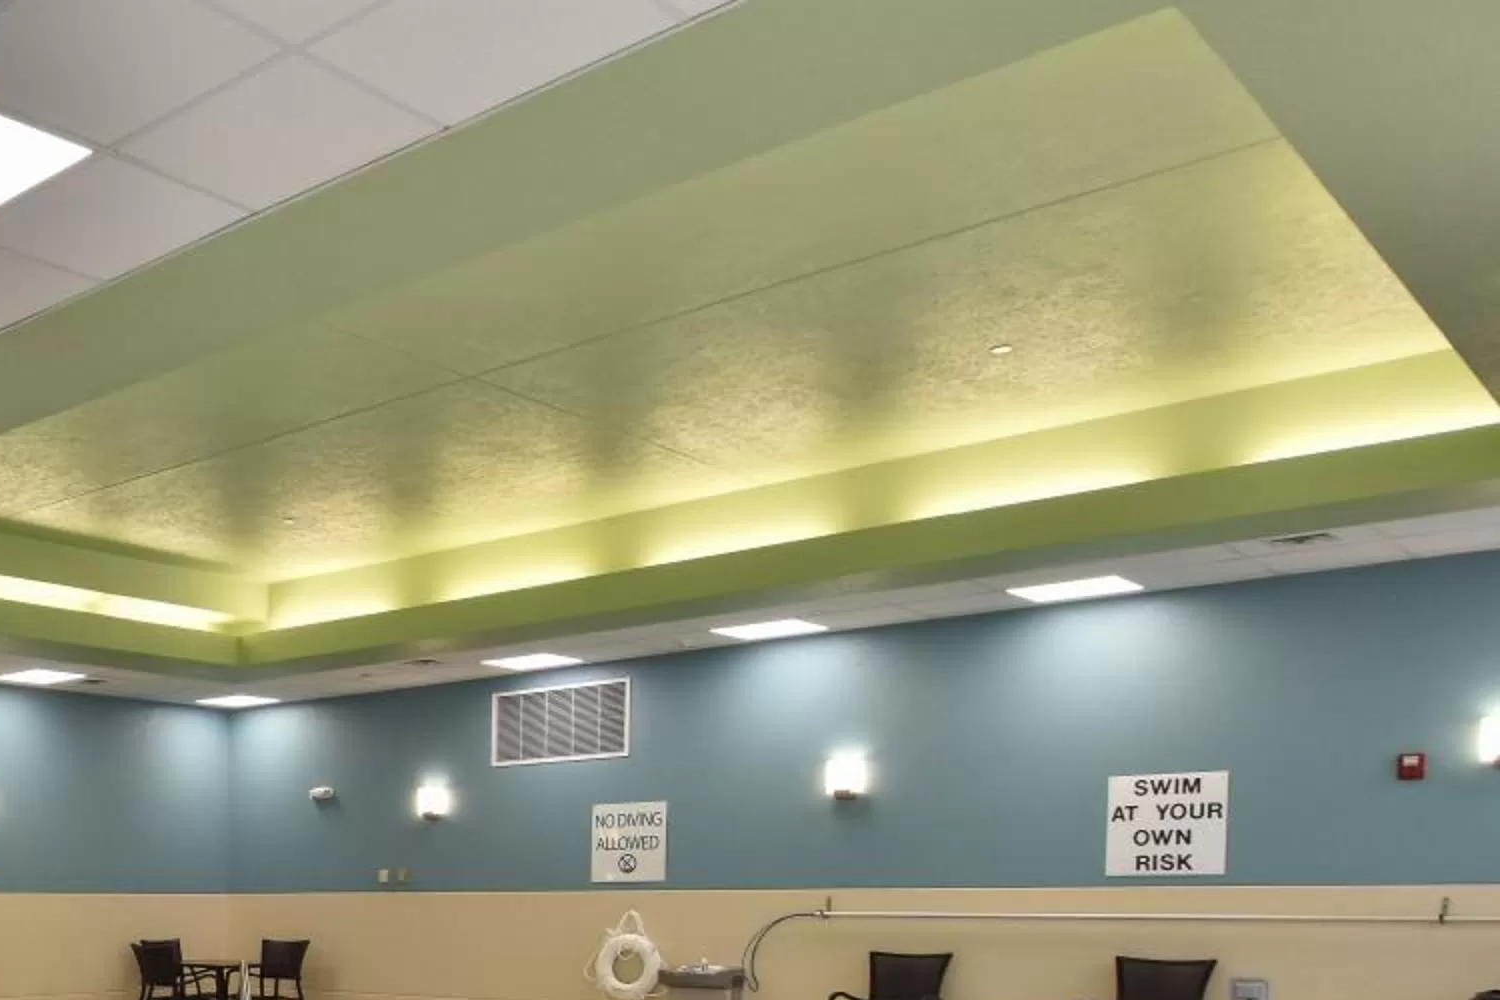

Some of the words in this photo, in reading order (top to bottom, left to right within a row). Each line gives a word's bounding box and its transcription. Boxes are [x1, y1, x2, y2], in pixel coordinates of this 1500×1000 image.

[1134, 777, 1202, 797] SWIM
[595, 813, 615, 829] NO
[617, 811, 663, 828] DIVING
[1111, 804, 1139, 823] AT
[1156, 802, 1224, 821] YOUR
[595, 835, 661, 851] ALLOWED
[1133, 829, 1193, 847] OWN
[1135, 853, 1193, 871] RISK
